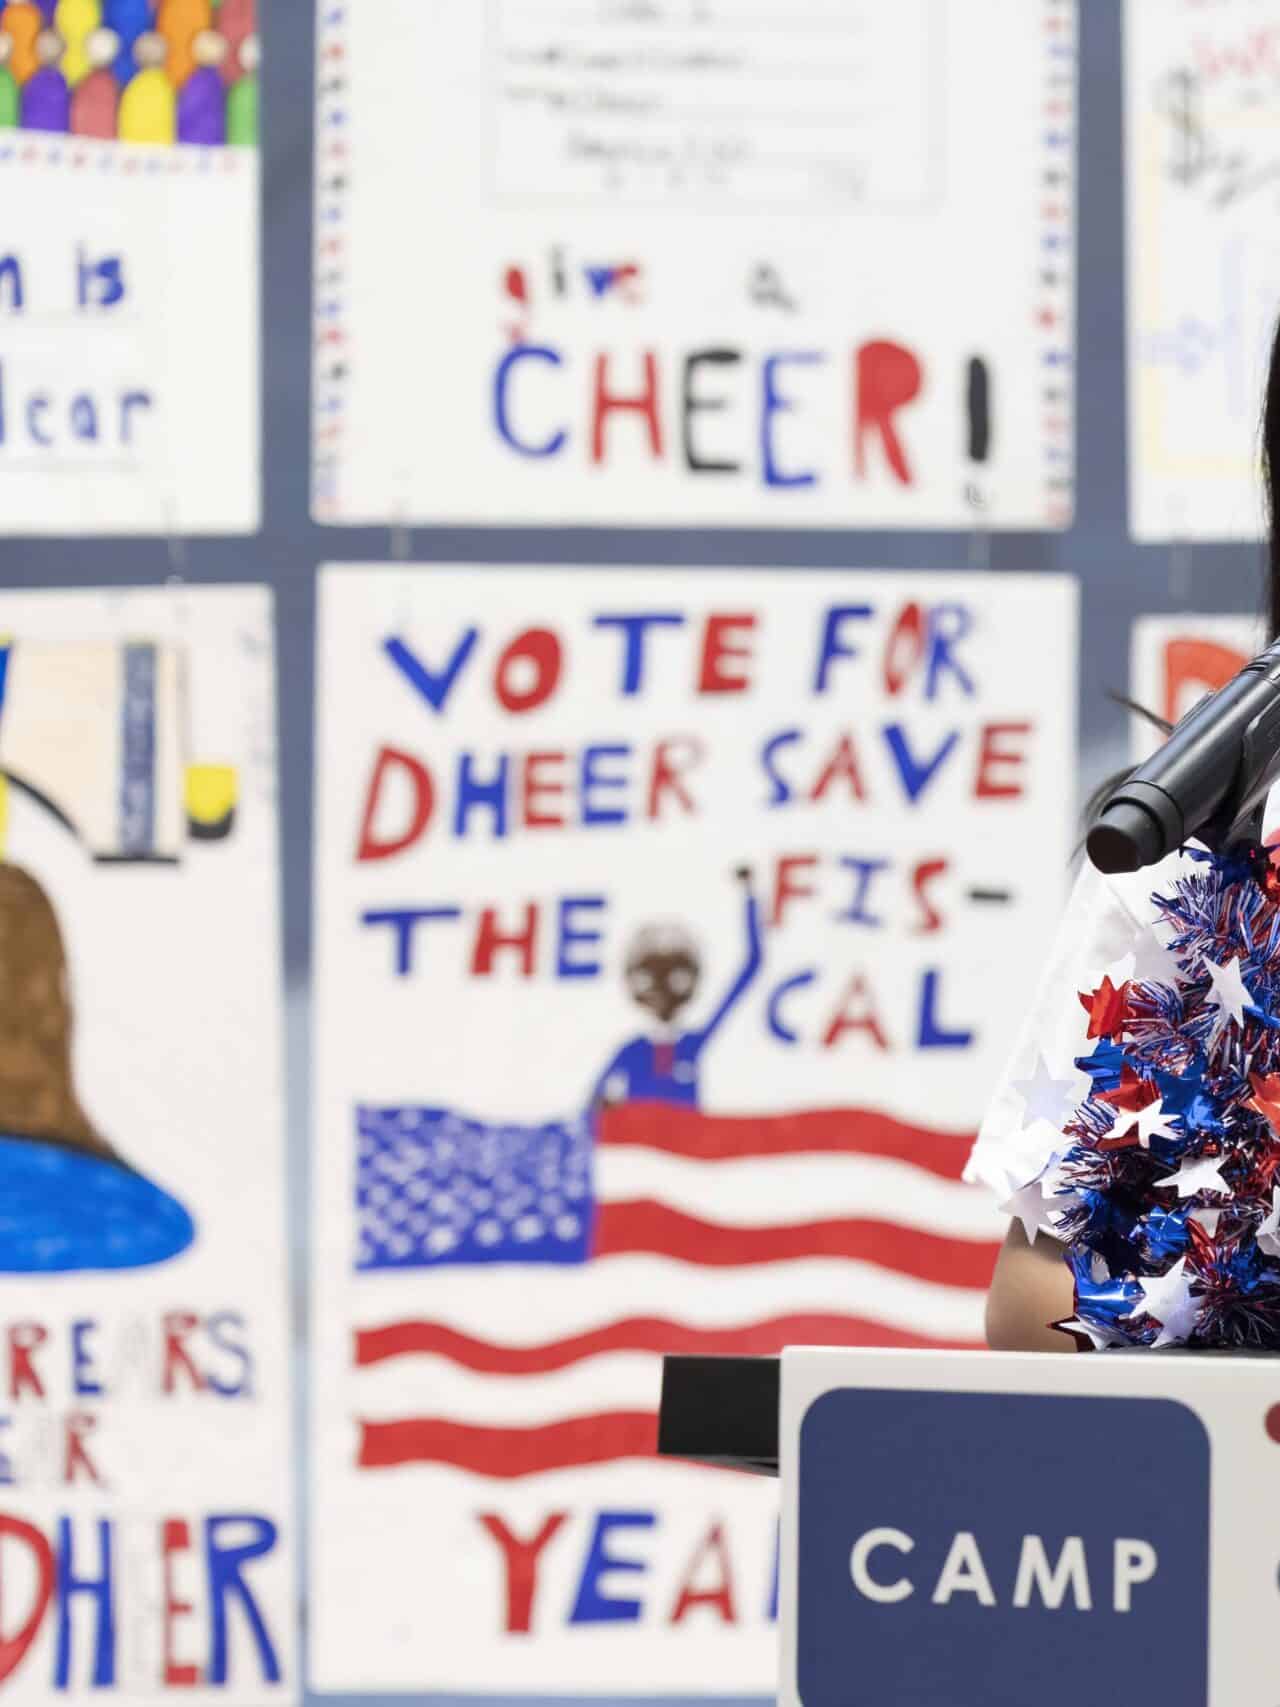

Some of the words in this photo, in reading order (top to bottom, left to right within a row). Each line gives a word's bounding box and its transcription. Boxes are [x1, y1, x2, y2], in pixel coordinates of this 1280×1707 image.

[382, 608, 758, 716] VOTE
[812, 600, 976, 702] FOR
[354, 738, 704, 864] DHEER
[760, 720, 1032, 810] SAVE
[360, 894, 608, 982] THE
[762, 968, 976, 1052] CAL
[476, 1508, 782, 1638] YEA
[850, 1527, 1159, 1613] CAMP
